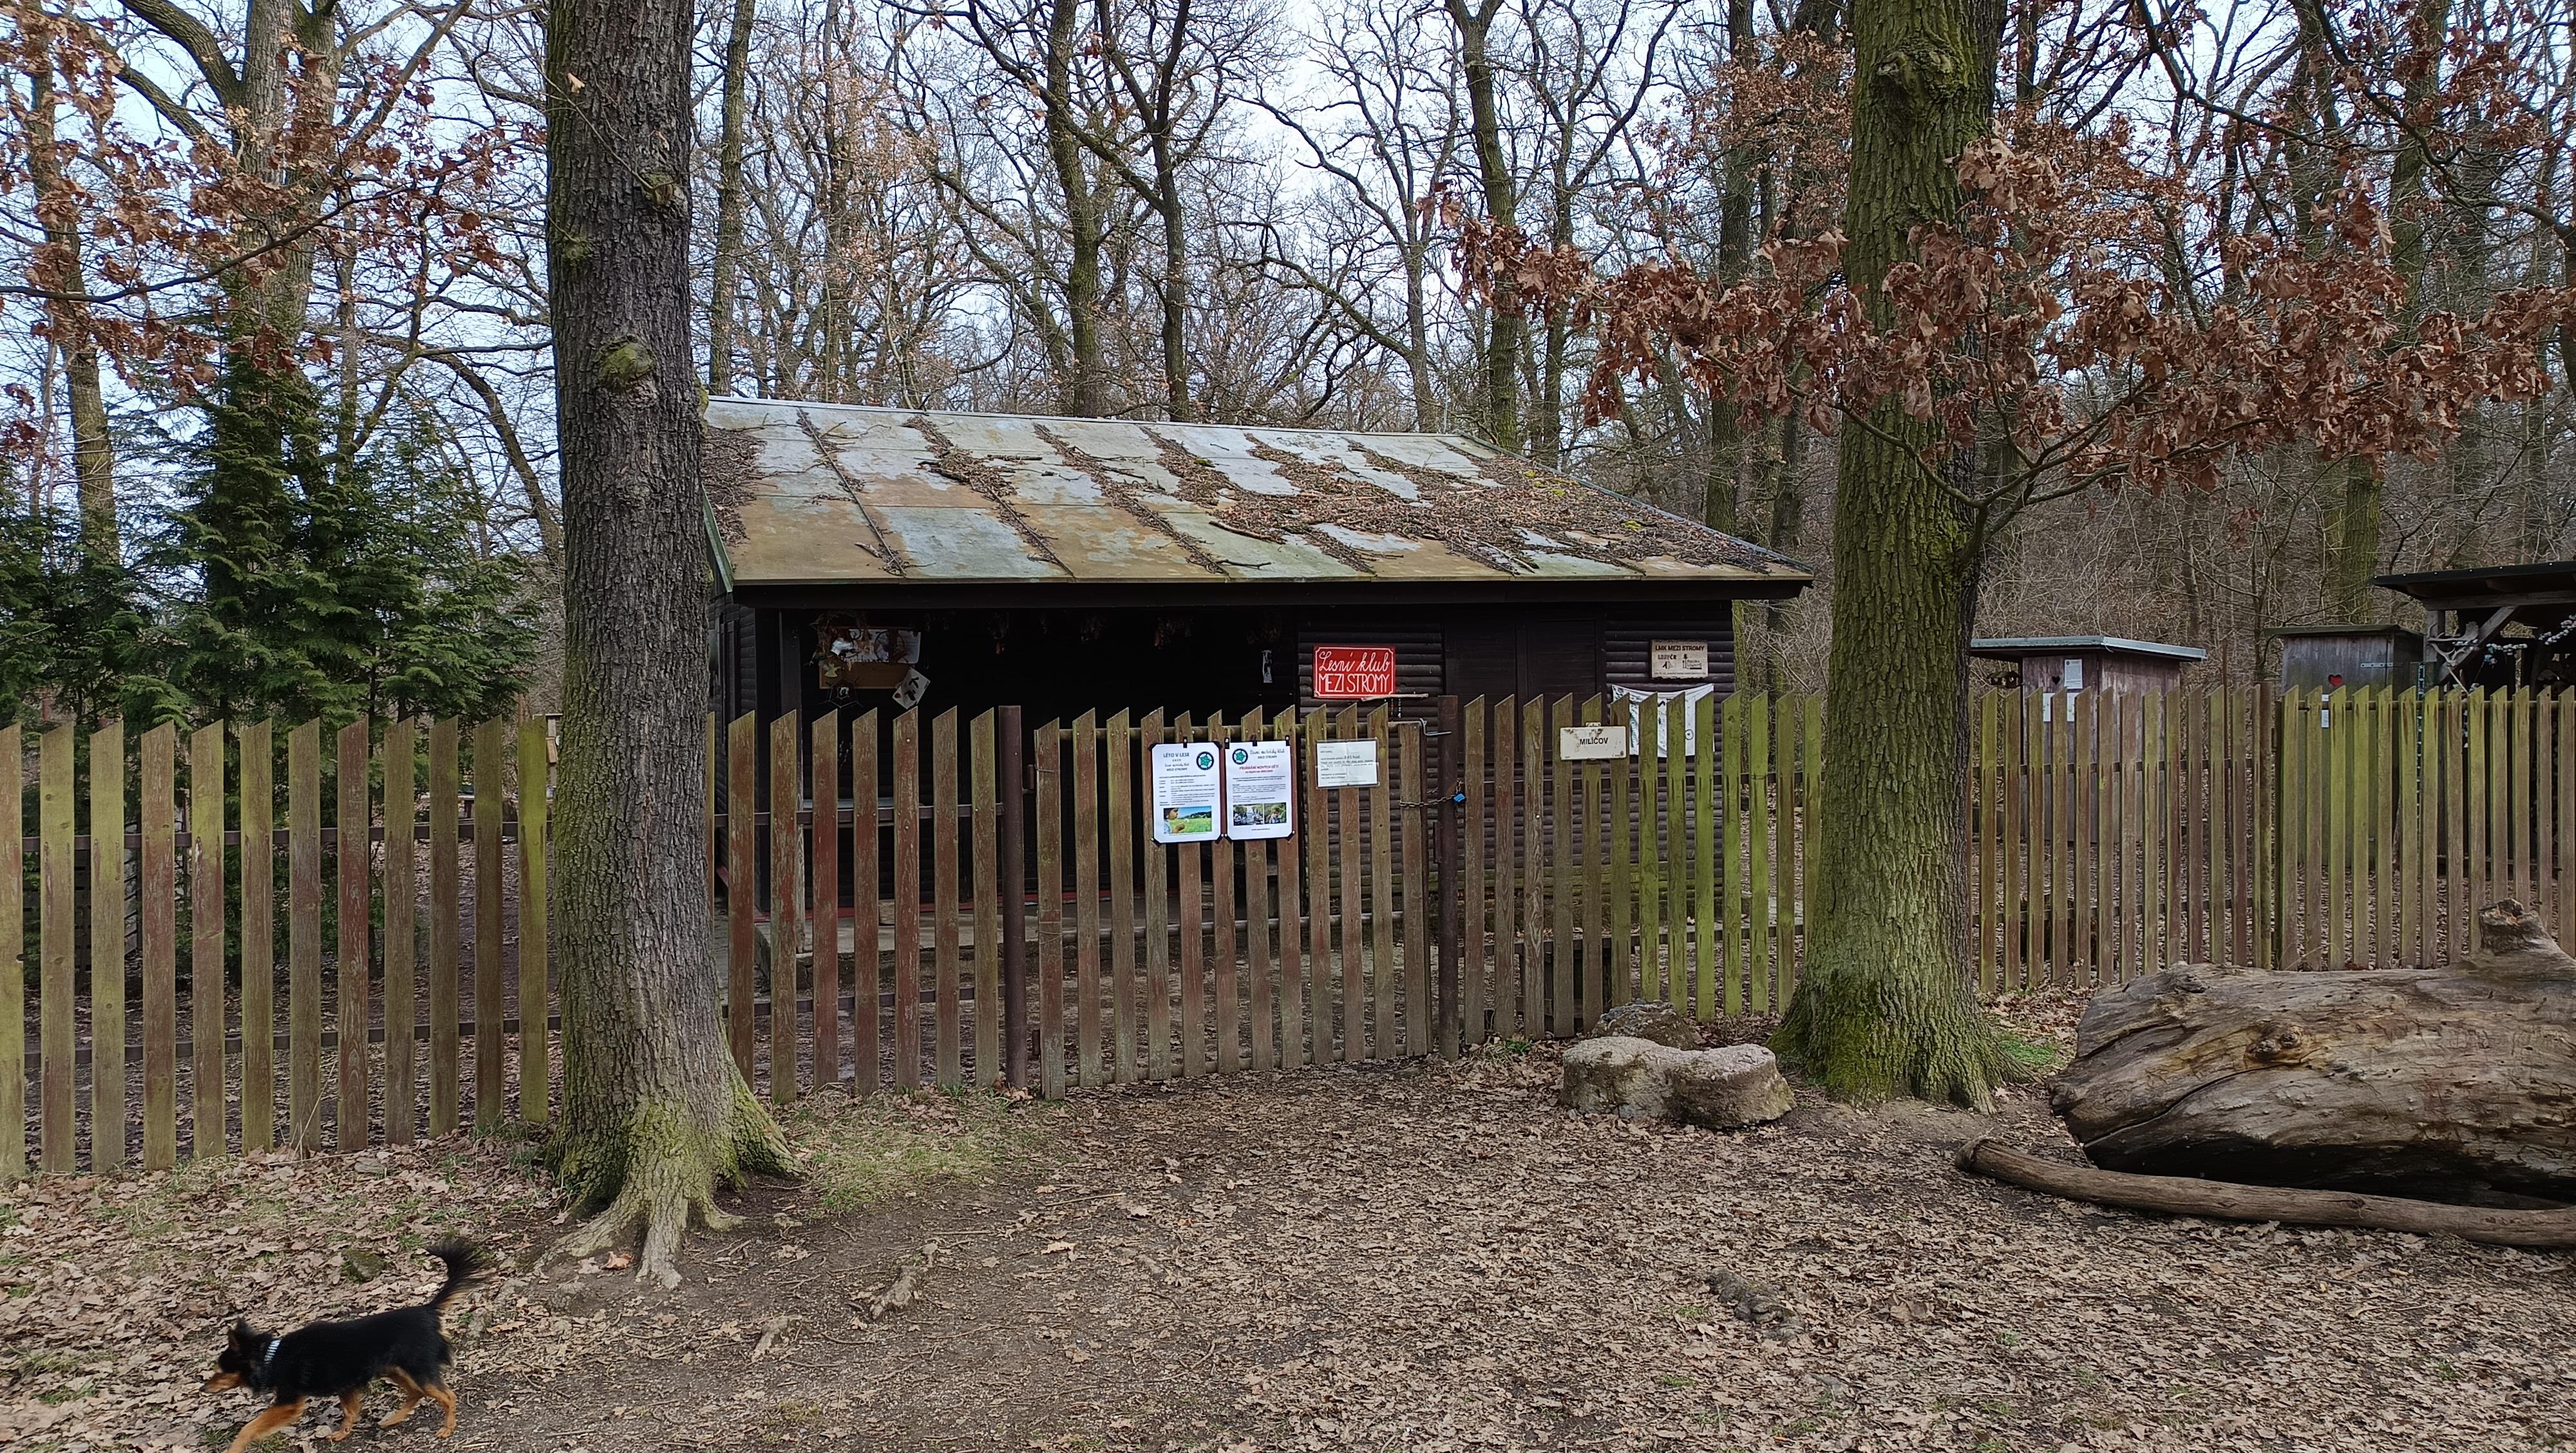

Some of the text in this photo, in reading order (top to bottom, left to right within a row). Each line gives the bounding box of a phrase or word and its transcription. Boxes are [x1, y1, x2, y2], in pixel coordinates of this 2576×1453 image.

[1319, 651, 1390, 672] Lesní klub
[1318, 673, 1390, 692] MEZI STROMY
